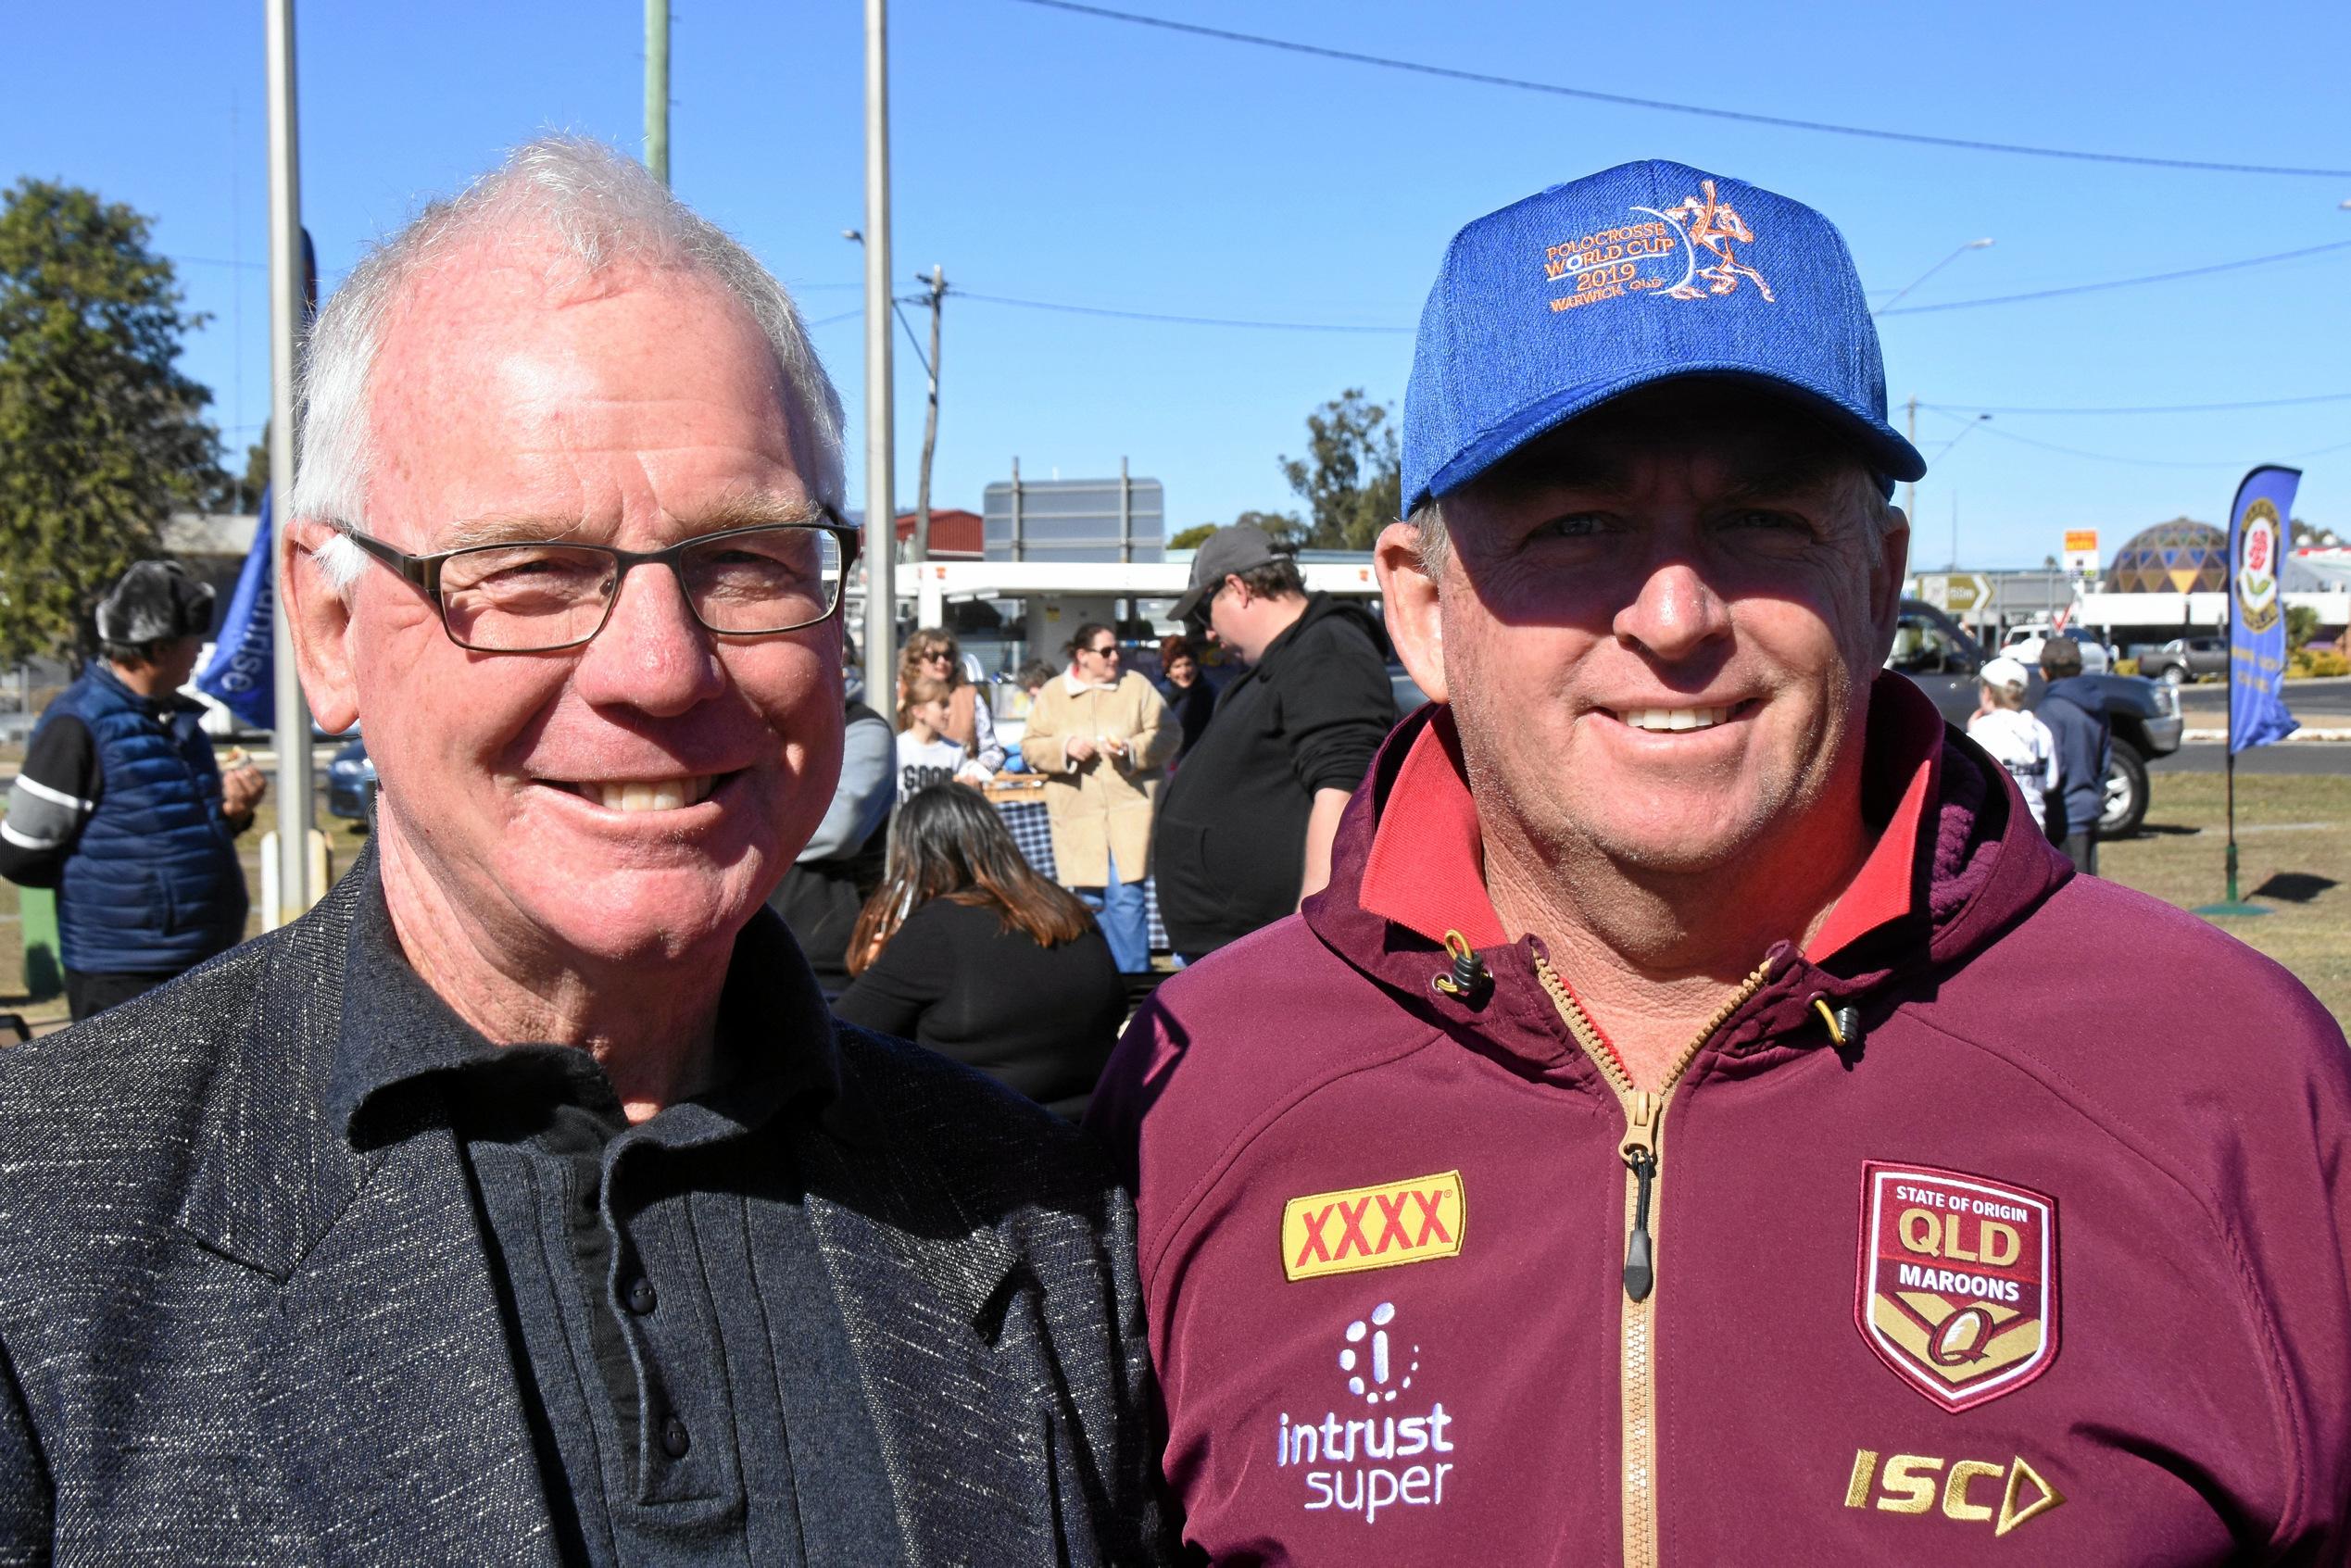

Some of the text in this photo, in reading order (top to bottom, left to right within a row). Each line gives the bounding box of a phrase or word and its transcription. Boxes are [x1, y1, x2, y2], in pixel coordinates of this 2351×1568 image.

[1544, 238, 1675, 278] WORLD CUP
[1546, 222, 1666, 260] POLOCROSSE
[1577, 263, 1636, 292] 2019
[1295, 1189, 1453, 1268] XXXX
[1896, 1185, 2028, 1223] STATE OF ORIGIN
[1899, 1208, 2021, 1267] QLD
[1899, 1263, 2019, 1302] MAROONS
[1277, 1402, 1454, 1467] intrust
[1304, 1462, 1453, 1524] super
[1844, 1448, 2005, 1522] ISC
